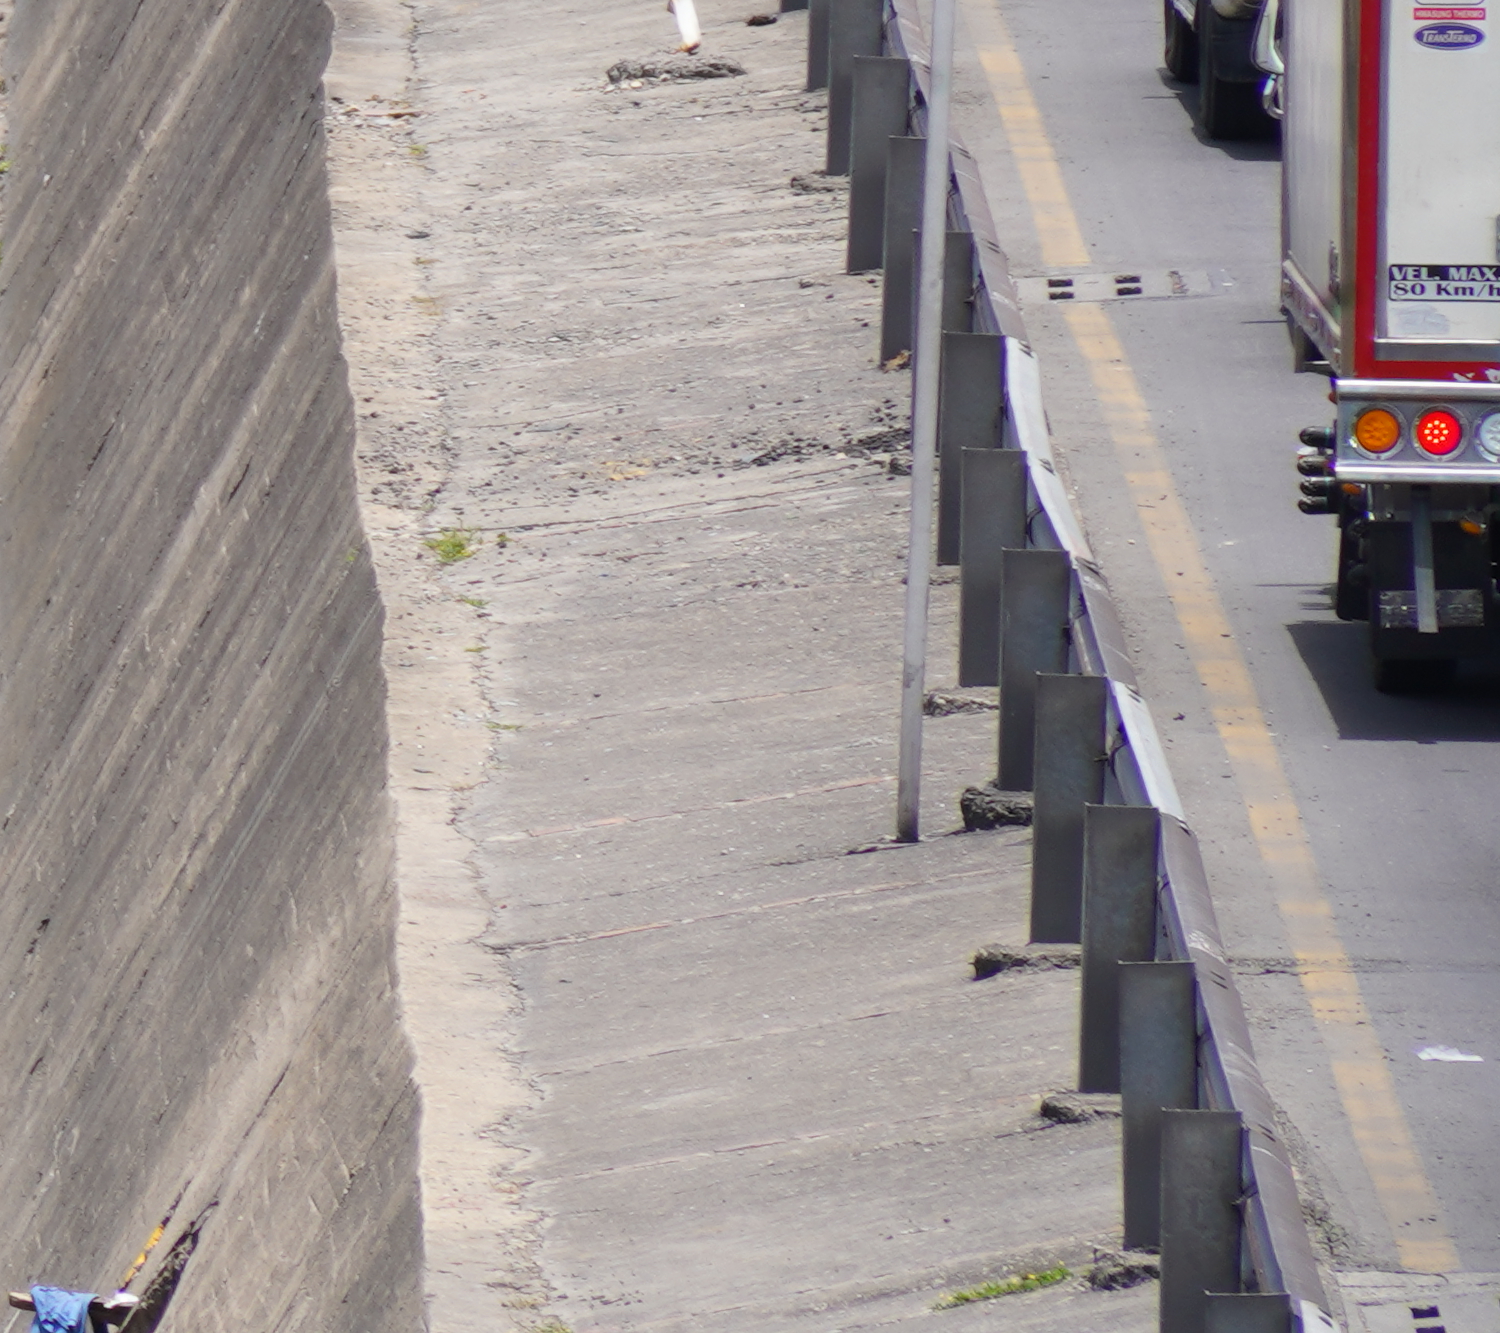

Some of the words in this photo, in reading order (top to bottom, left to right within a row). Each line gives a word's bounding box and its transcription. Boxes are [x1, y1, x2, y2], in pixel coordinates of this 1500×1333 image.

[1391, 266, 1441, 281] VEL.
[1393, 282, 1426, 296] 80
[1436, 283, 1500, 297] Km/h
